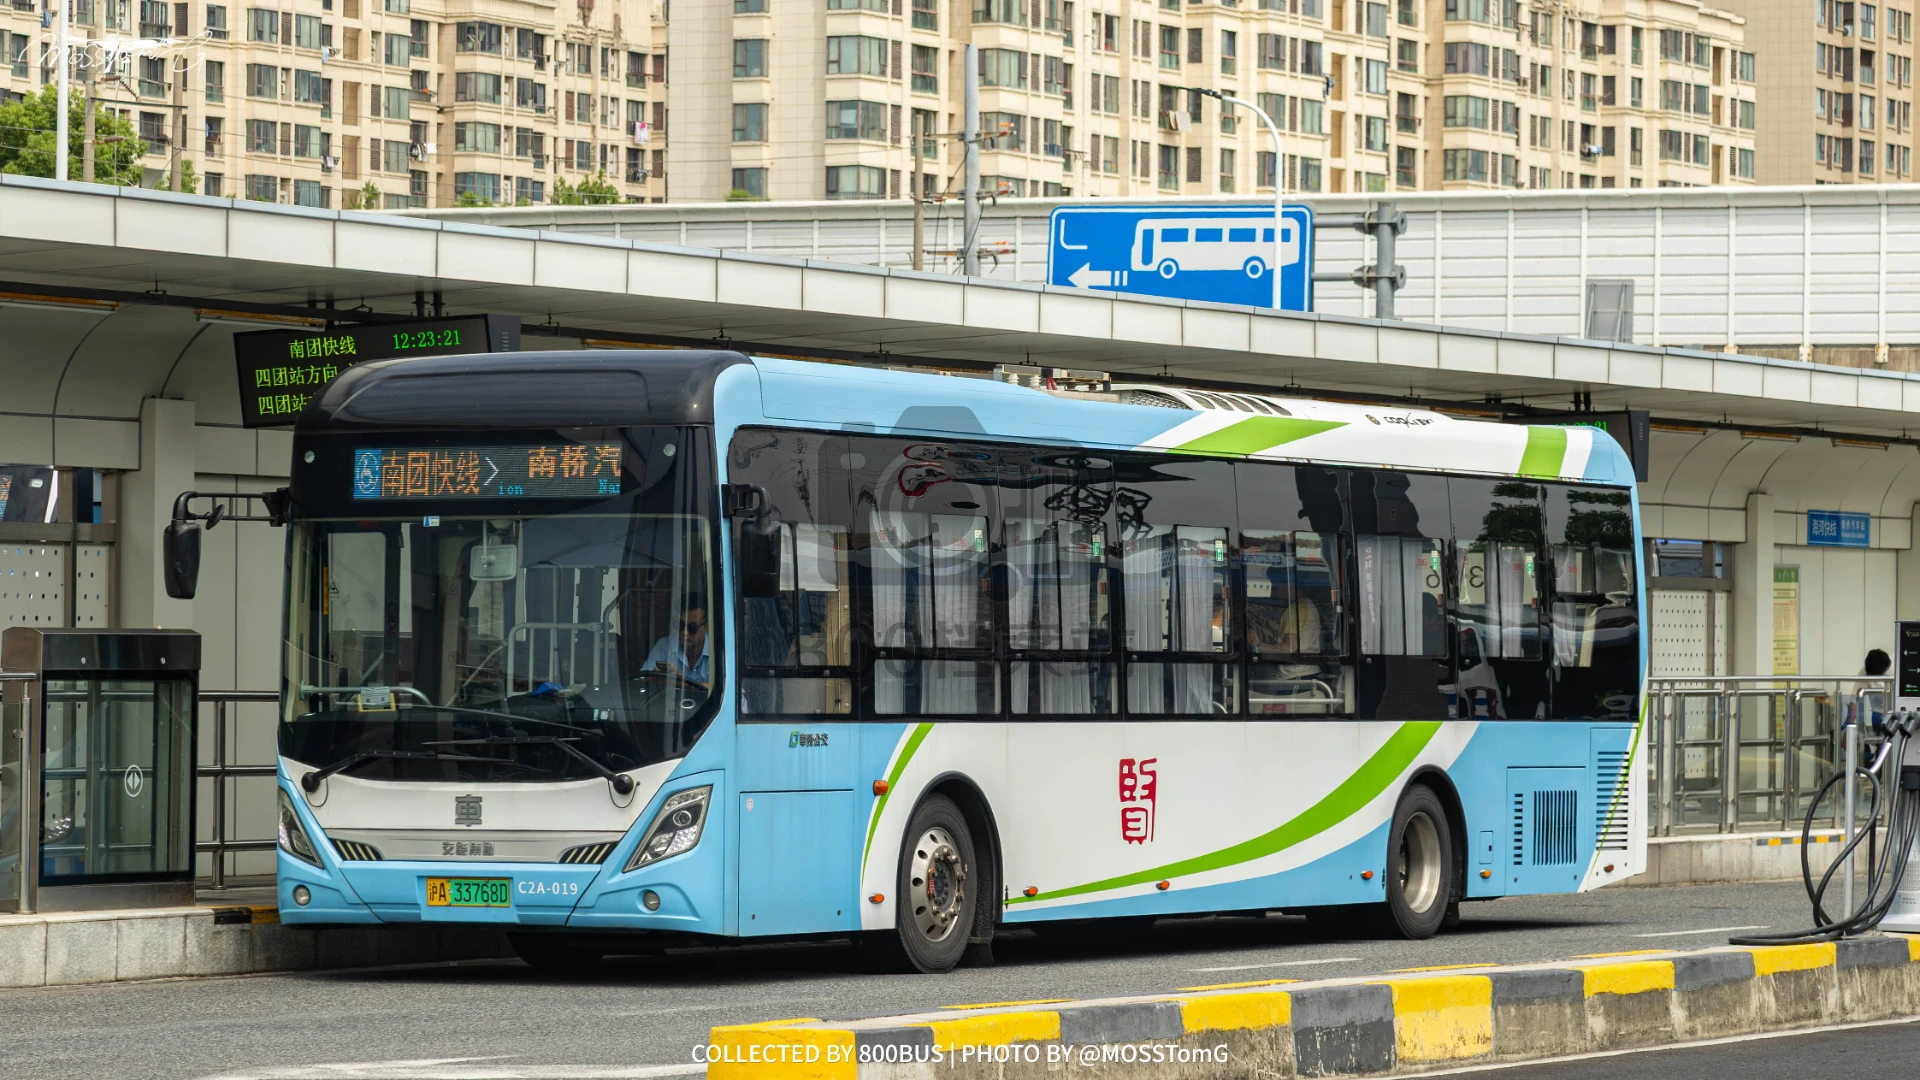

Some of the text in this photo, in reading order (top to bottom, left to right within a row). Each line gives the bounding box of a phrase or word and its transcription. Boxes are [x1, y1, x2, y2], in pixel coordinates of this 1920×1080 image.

[288, 335, 357, 359] 南团快线
[392, 329, 462, 350] 12:23:21
[255, 364, 338, 388] 四团站方向
[381, 444, 622, 497] 南团快线 南桥汽
[518, 881, 578, 895] C2A-019
